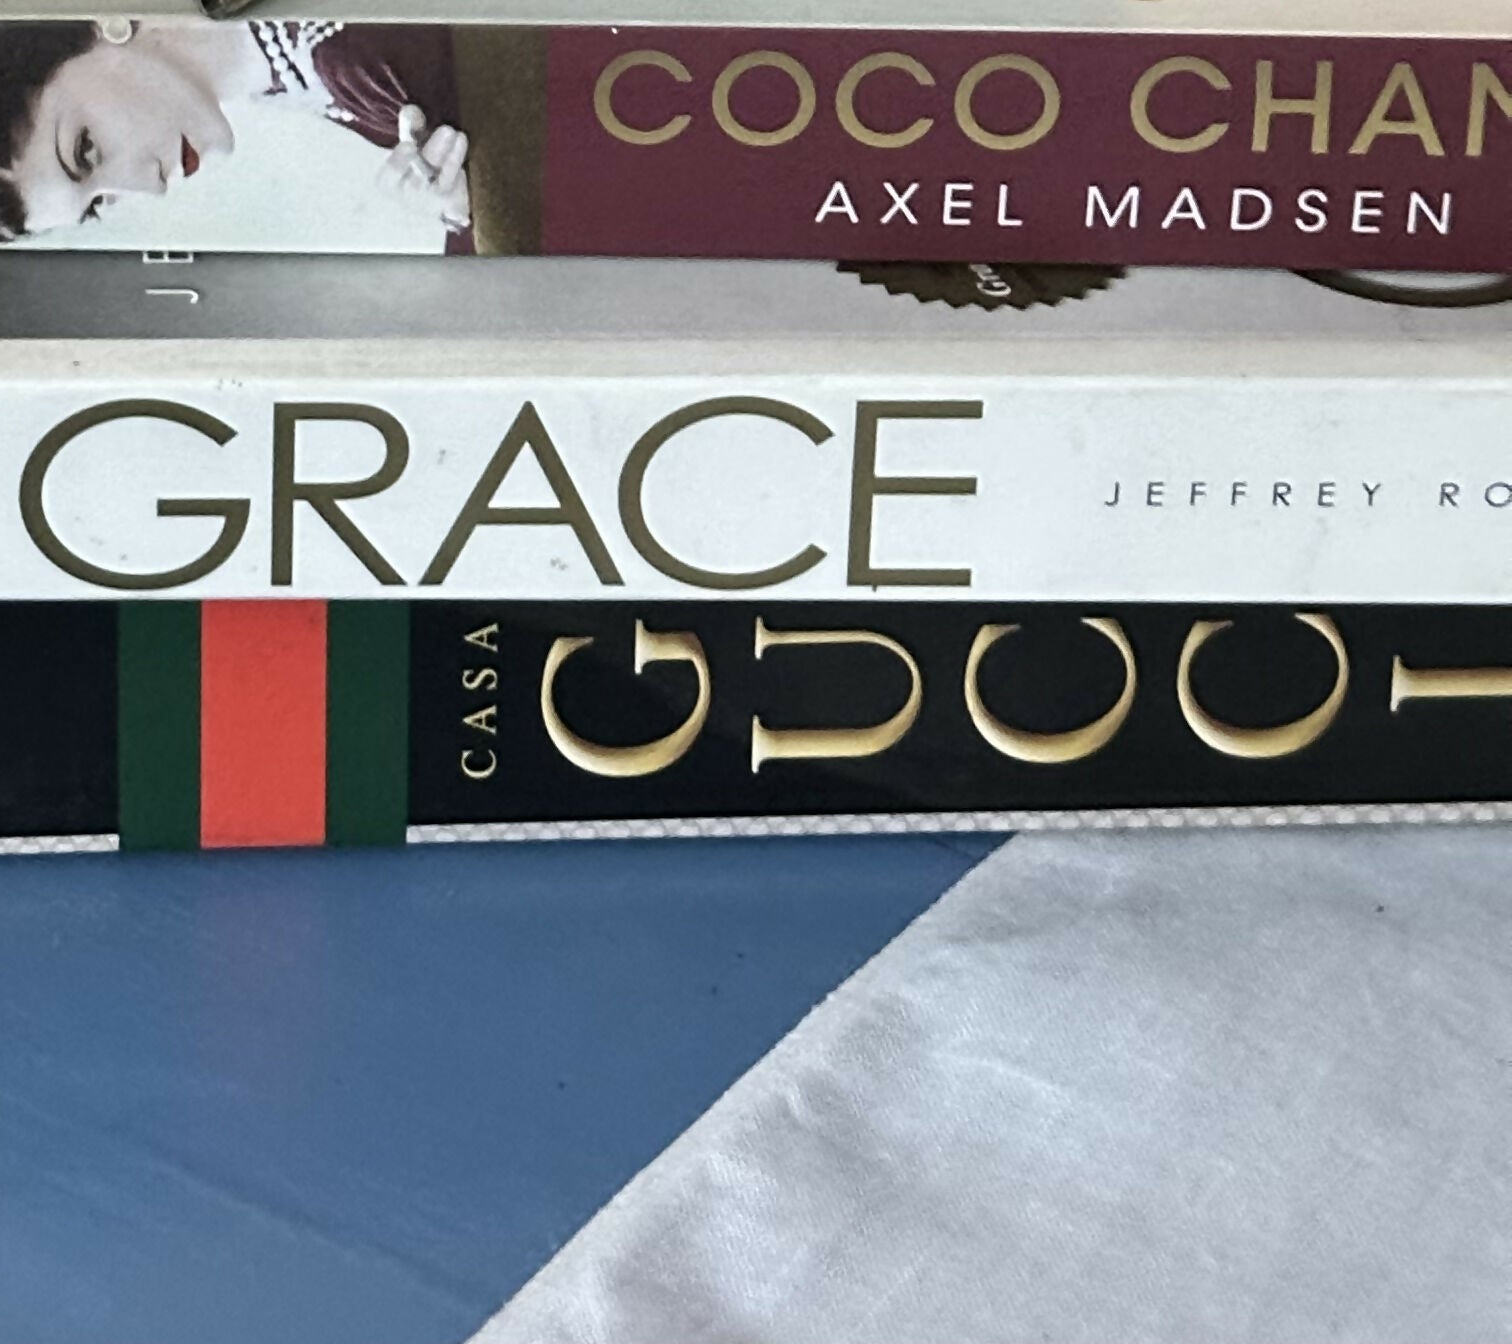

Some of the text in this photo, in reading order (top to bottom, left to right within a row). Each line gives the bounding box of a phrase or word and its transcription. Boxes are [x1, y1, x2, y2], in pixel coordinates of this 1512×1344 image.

[593, 49, 1061, 151] COCO
[815, 180, 1454, 236] AXEL MADSEN
[19, 395, 984, 591] GRACE
[1104, 480, 1382, 509] JEFFREY
[460, 622, 499, 779] CASA
[540, 612, 1512, 778] GUCCI
